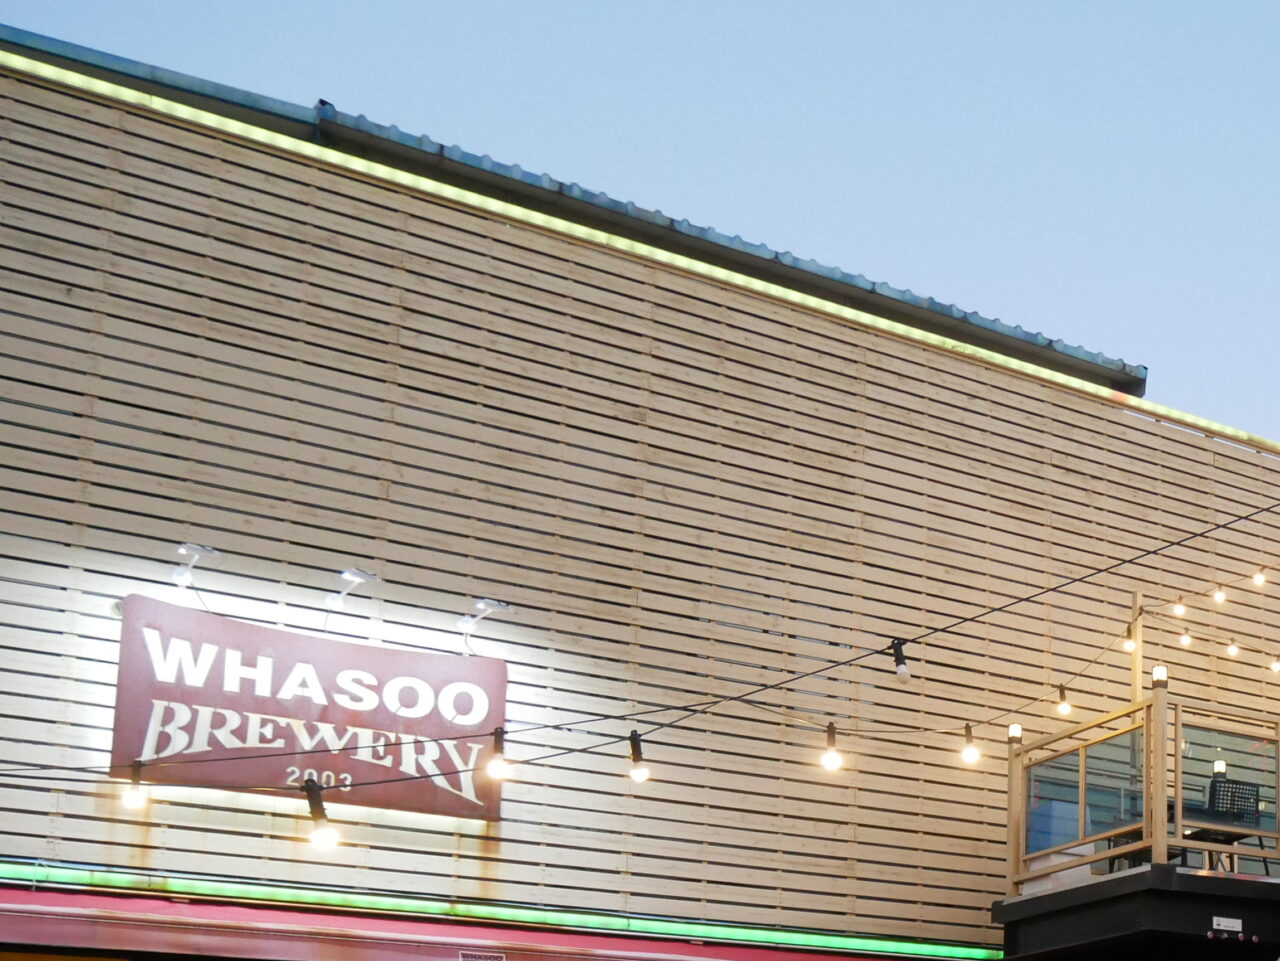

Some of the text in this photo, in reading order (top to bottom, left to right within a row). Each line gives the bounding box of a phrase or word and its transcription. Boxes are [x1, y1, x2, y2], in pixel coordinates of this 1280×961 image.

[142, 627, 489, 725] WHASOO
[138, 698, 484, 806] BREWERY
[286, 766, 352, 791] 2003
